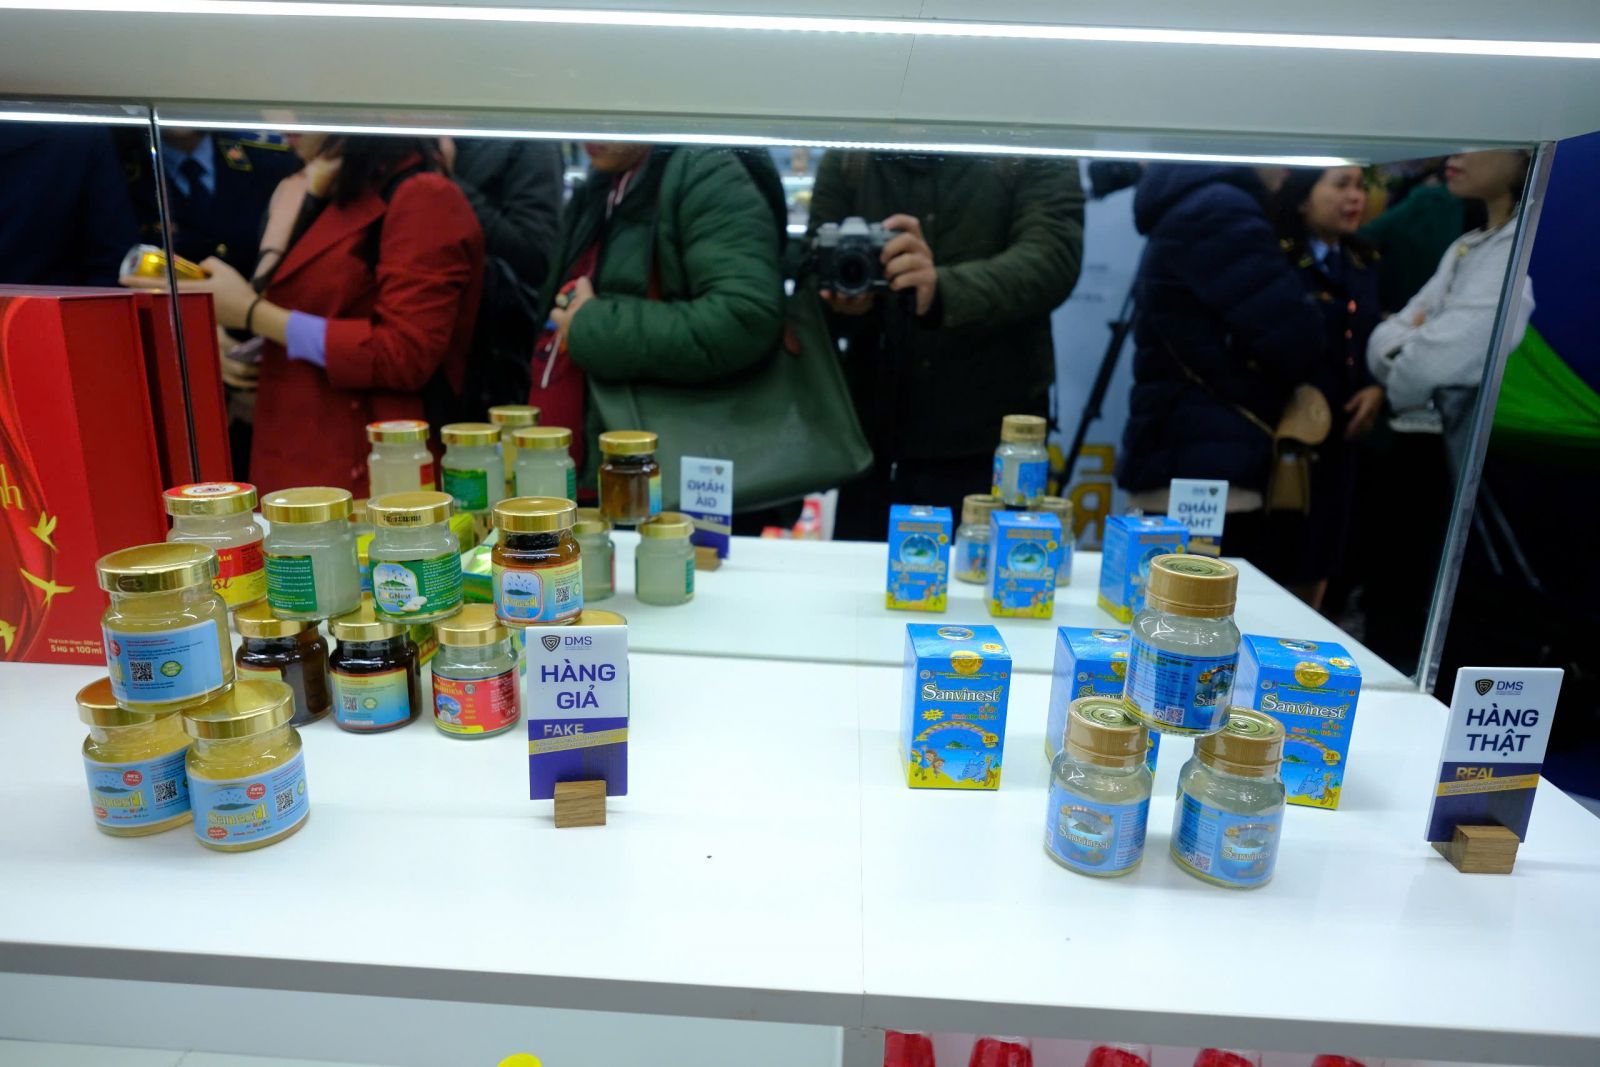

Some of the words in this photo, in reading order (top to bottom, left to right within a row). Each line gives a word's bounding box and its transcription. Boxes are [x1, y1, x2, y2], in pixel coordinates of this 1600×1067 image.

[76, 646, 91, 654] 100
[564, 636, 592, 646] DMS
[541, 658, 616, 682] HÀNG
[922, 682, 1000, 702] Sanvinest
[1496, 681, 1523, 690] DMS
[556, 684, 599, 709] GIẢ
[1261, 693, 1346, 719] Sanvinest
[1466, 703, 1539, 727] HÀNG
[544, 724, 584, 736] FAKE
[1466, 728, 1532, 757] THẬT
[1455, 767, 1494, 780] REAL
